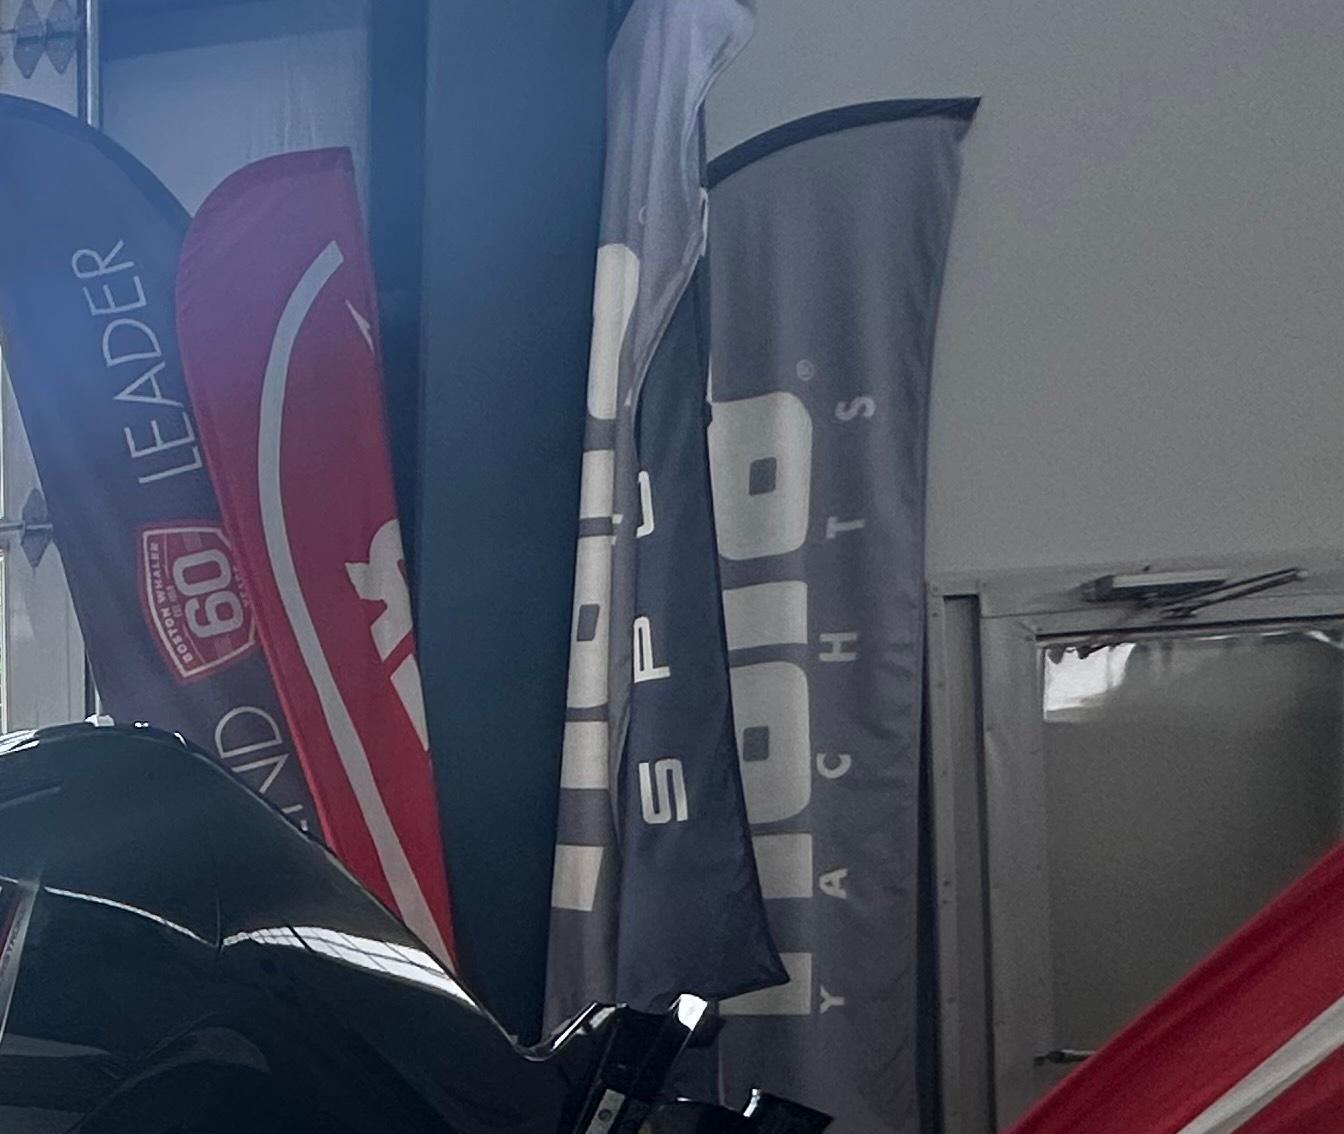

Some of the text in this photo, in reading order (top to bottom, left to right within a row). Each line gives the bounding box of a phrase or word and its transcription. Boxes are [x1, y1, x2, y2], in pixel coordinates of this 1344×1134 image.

[71, 239, 203, 485] LEADER
[149, 542, 167, 606] WHALER
[172, 548, 244, 638] 60
[161, 608, 194, 664] BOSTON
